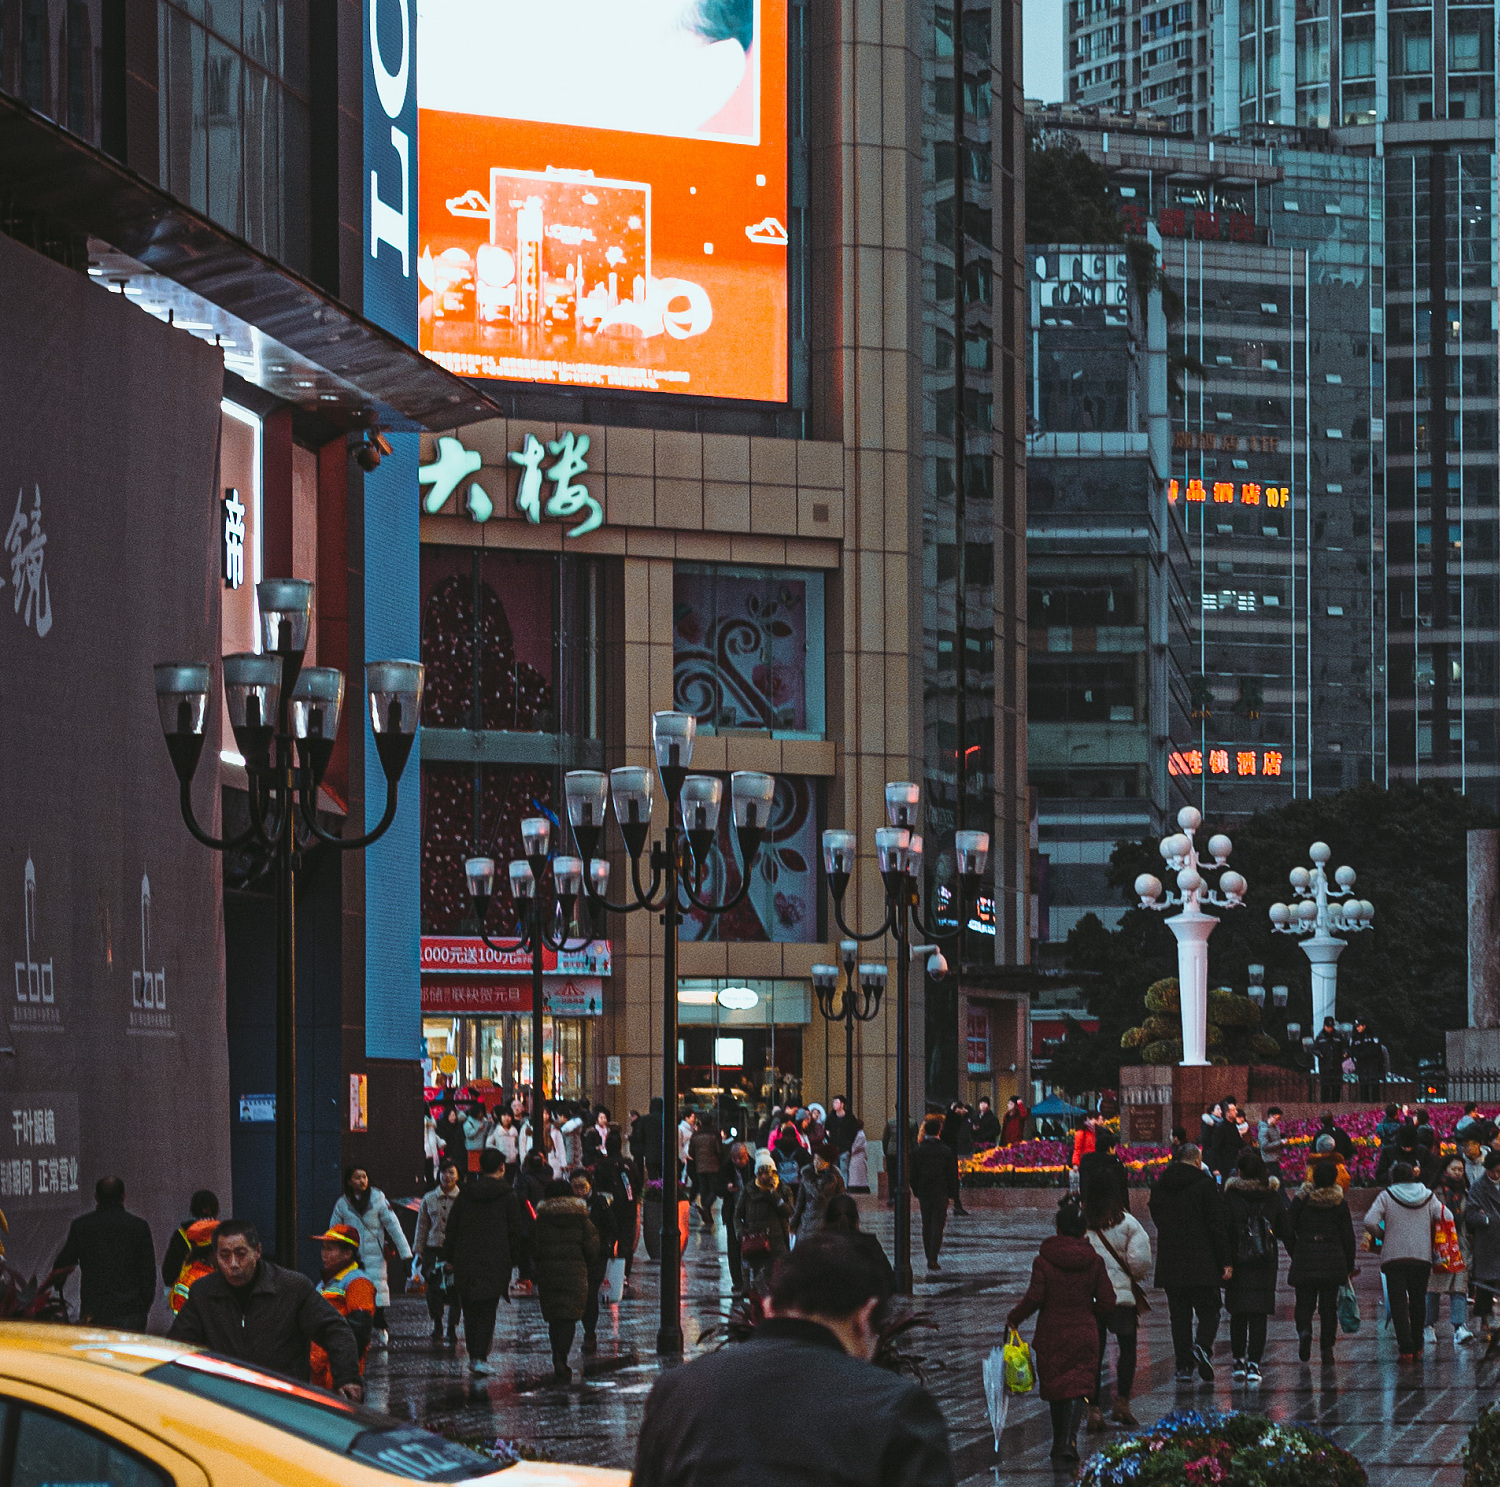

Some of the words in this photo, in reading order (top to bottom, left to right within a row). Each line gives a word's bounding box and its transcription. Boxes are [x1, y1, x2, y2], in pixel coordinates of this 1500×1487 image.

[418, 430, 603, 538] 大楼
[420, 946, 516, 965] 000元送100元
[38, 1155, 79, 1194] 正常营业
